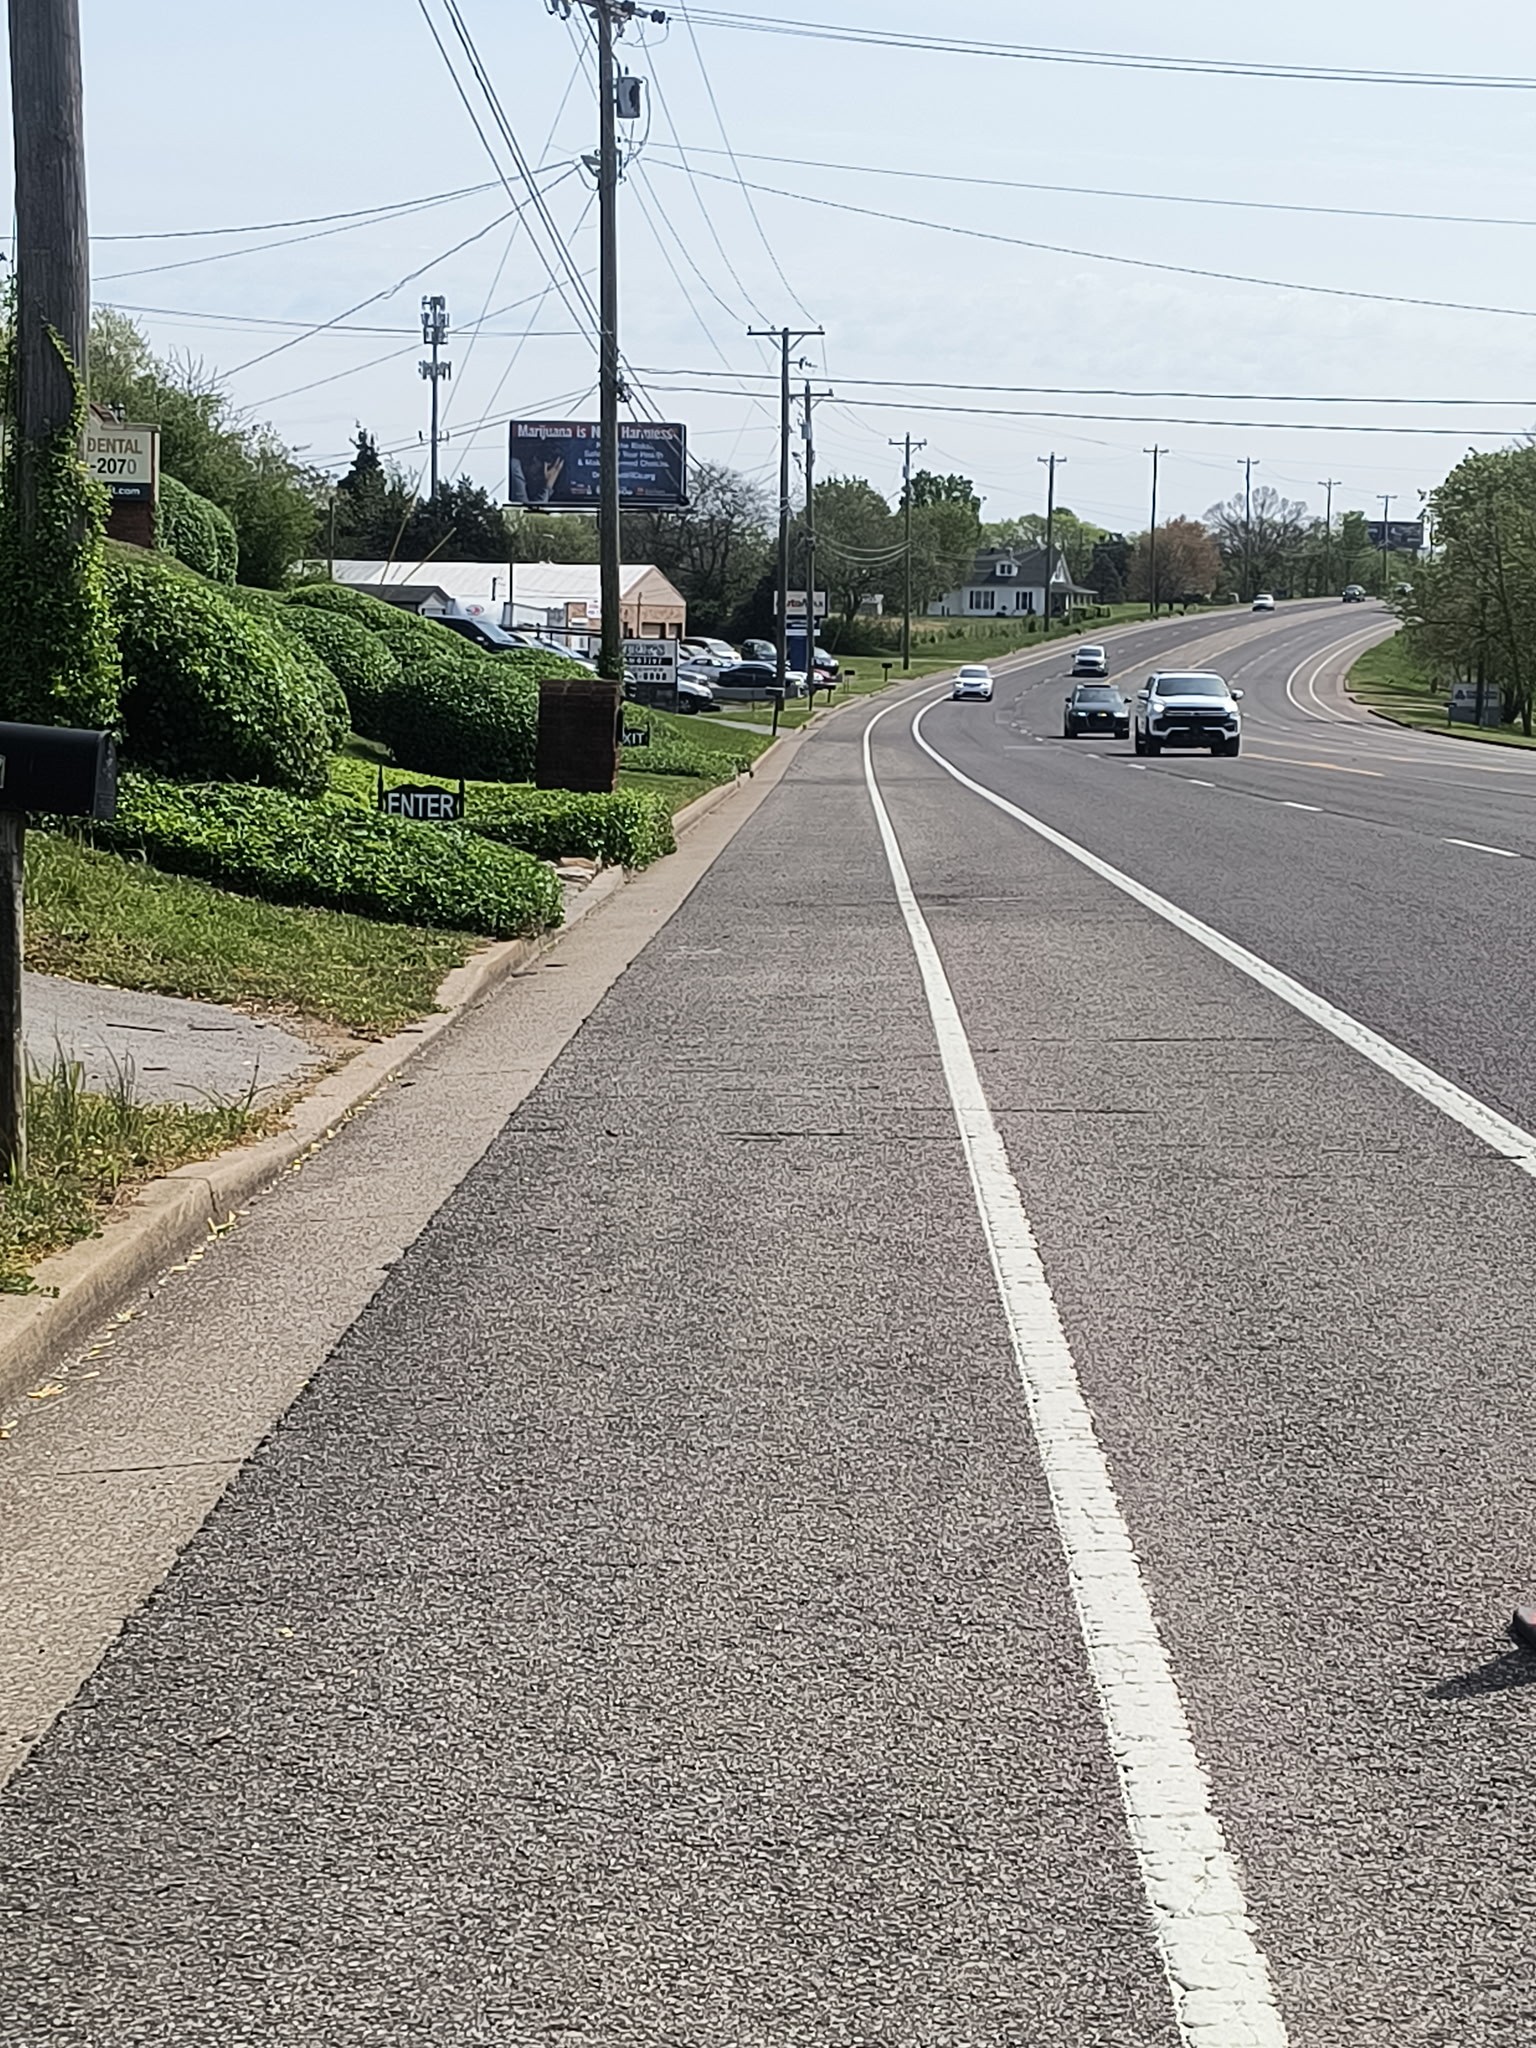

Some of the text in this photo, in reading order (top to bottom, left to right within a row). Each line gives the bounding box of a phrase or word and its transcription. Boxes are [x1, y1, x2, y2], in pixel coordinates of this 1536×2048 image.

[517, 423, 573, 440] Marijuana
[576, 424, 587, 438] is
[87, 437, 143, 455] DENTAL
[90, 457, 137, 475] -2070
[623, 732, 645, 745] XIT
[387, 793, 454, 818] ENTER
